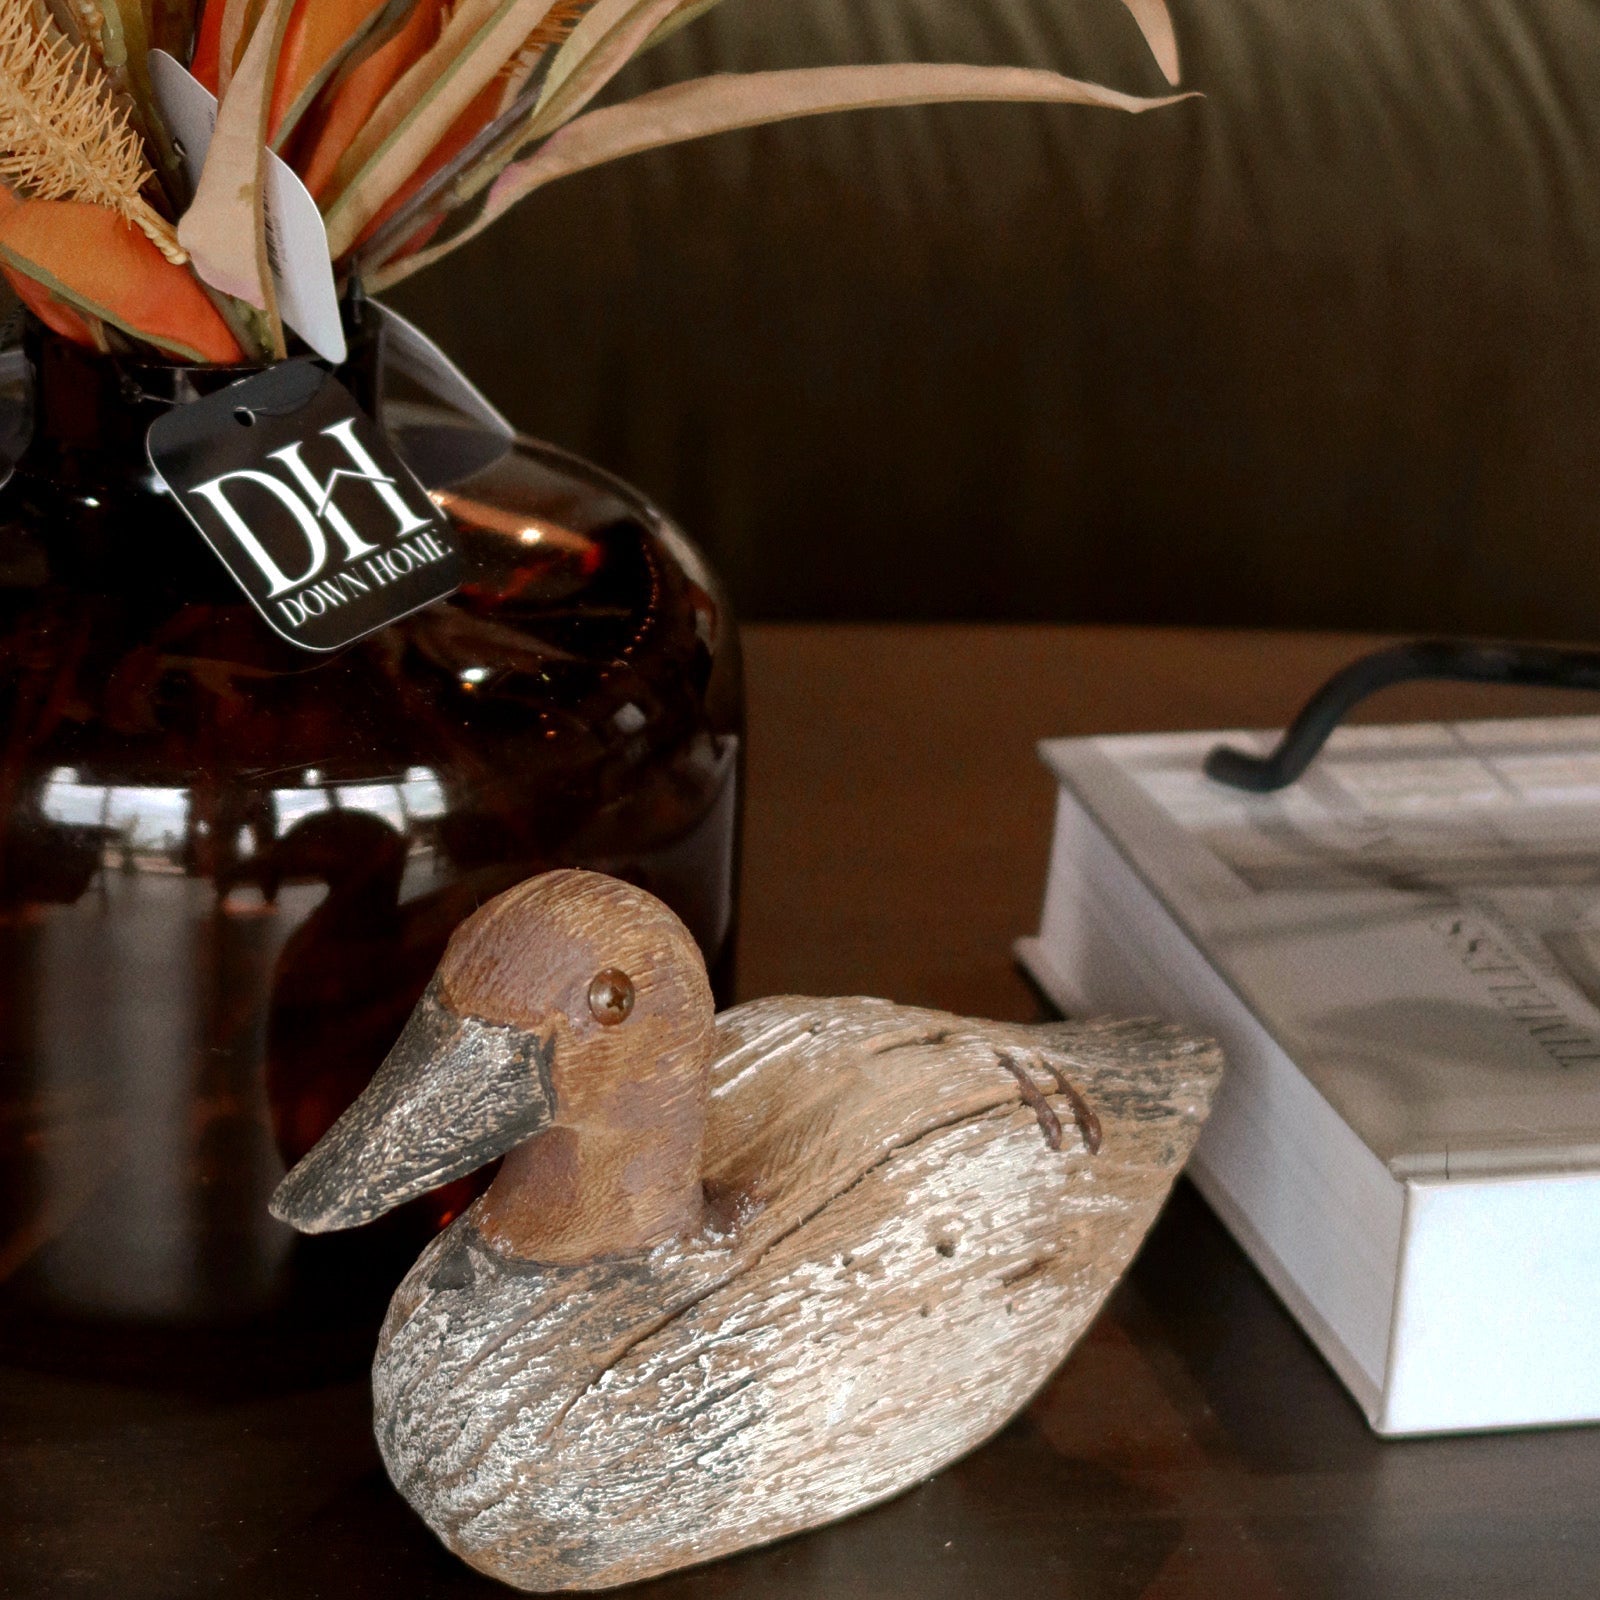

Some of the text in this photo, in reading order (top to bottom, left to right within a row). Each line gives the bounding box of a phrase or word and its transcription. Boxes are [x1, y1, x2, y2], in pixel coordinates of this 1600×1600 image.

[188, 417, 433, 598] DH
[276, 529, 453, 627] DOWN HOME
